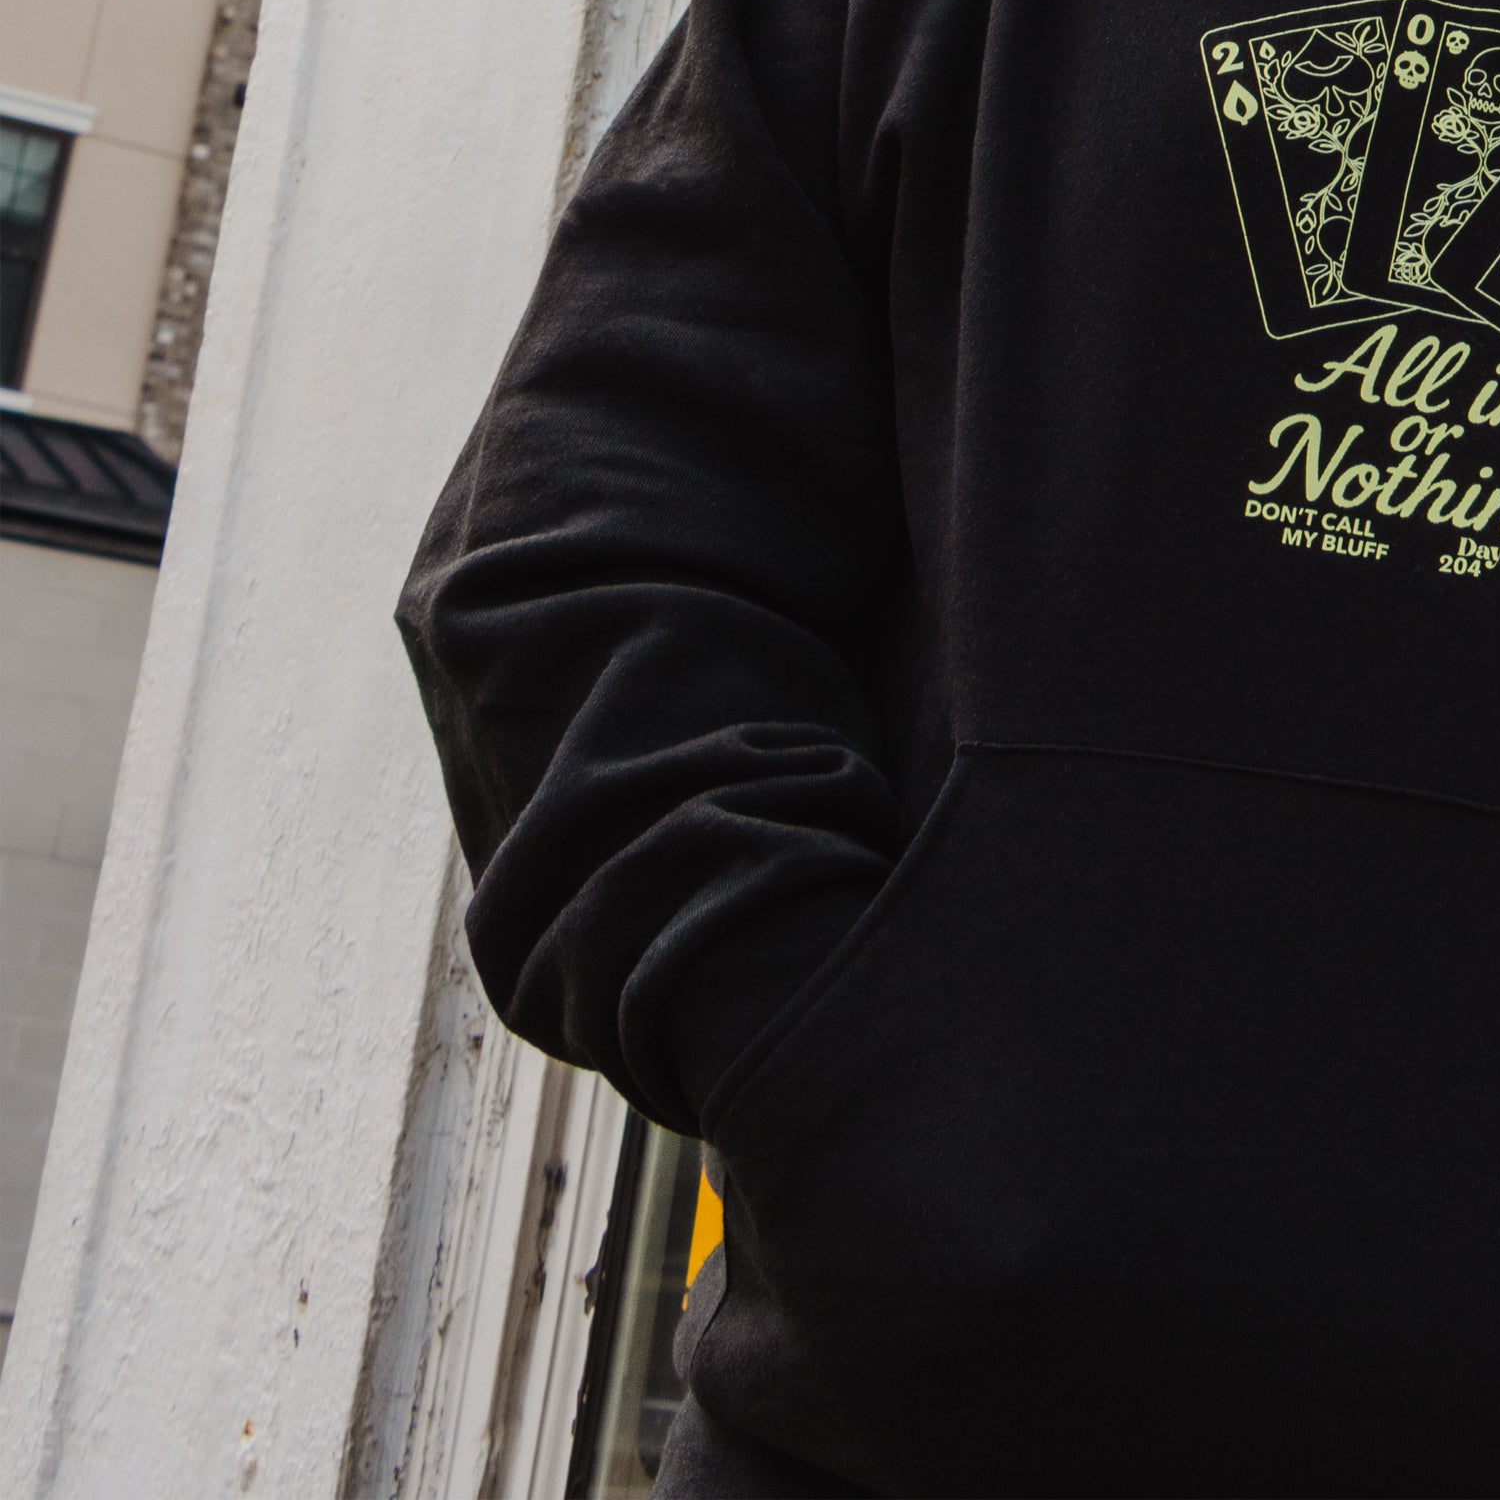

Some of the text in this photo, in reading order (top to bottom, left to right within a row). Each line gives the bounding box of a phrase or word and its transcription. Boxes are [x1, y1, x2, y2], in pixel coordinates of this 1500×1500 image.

[1407, 14, 1435, 45] 0
[1212, 41, 1244, 75] 2
[1294, 324, 1472, 414] All
[1390, 415, 1465, 455] or
[1245, 499, 1375, 539] DON'T CALL
[1282, 526, 1390, 560] MY BLUFF
[1438, 555, 1482, 578] 204
